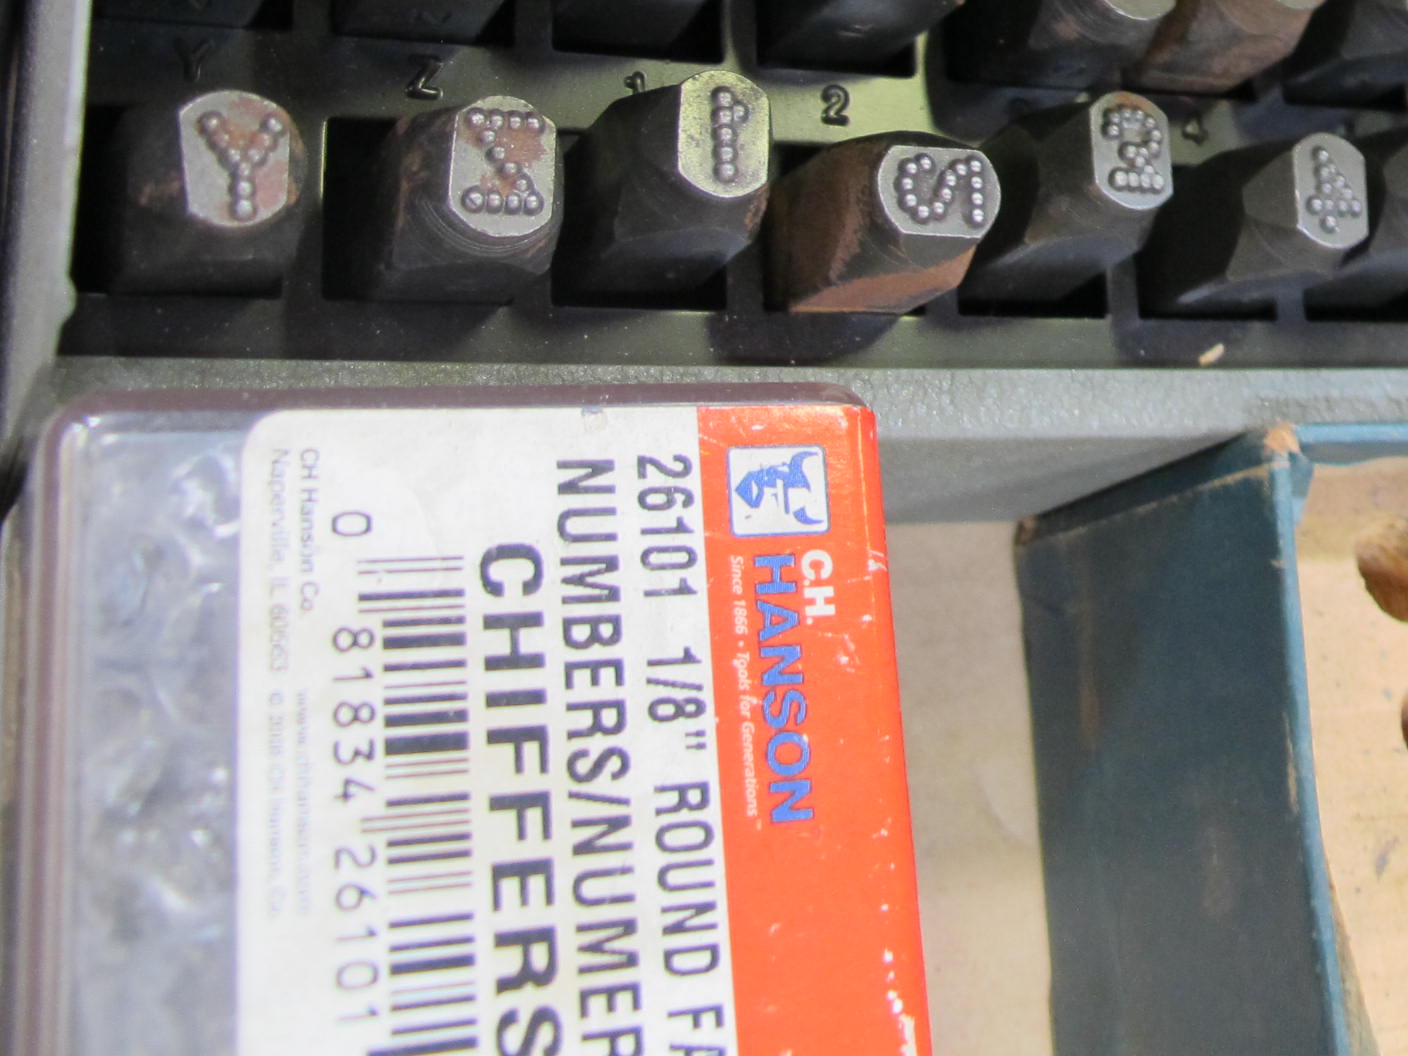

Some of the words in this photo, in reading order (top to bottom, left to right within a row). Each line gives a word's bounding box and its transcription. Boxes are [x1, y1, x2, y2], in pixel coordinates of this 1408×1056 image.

[405, 53, 444, 101] Z
[819, 84, 851, 127] 2
[196, 108, 287, 221] Y
[300, 448, 320, 481] CH
[300, 487, 319, 574] Hanson
[331, 510, 372, 537] 0
[636, 454, 698, 598] 26101
[720, 555, 745, 595] Since
[800, 549, 836, 626] C.H.
[733, 599, 748, 635] 1866
[646, 646, 708, 751] 1/8"
[736, 650, 753, 692] Tools
[740, 695, 757, 722] for
[754, 553, 814, 824] HANSON
[331, 627, 375, 803] 81834
[479, 542, 563, 1056] CHIFFERS
[653, 780, 721, 978] ROUND
[333, 845, 379, 1022] 26101
